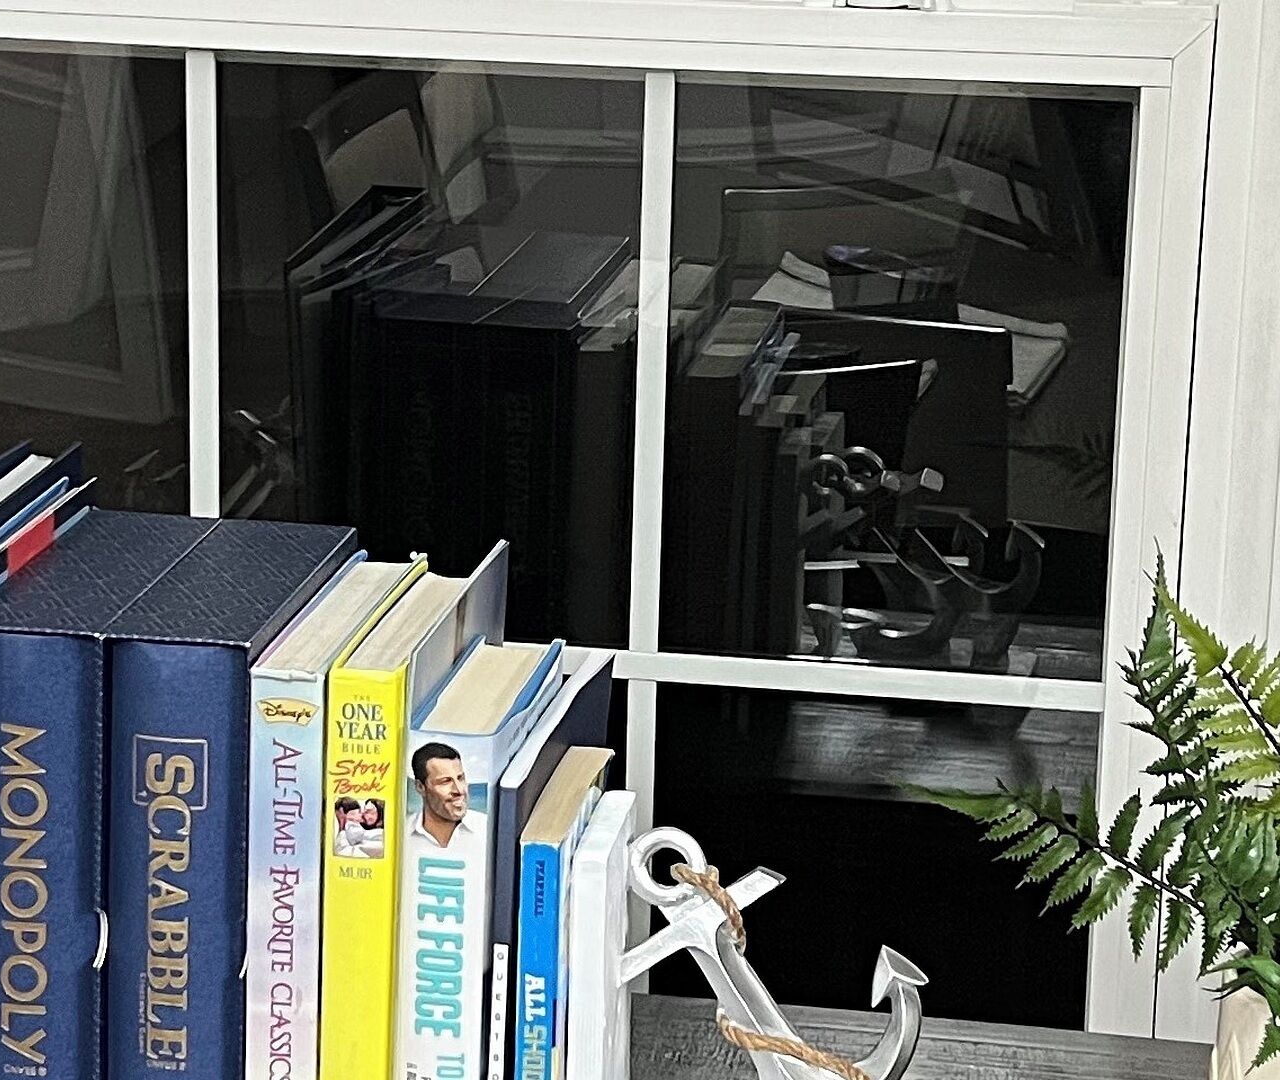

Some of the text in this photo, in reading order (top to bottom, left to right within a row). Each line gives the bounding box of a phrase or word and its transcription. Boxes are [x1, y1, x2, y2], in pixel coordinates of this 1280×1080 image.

[342, 703, 384, 721] ONE
[336, 720, 387, 740] YEAR
[342, 742, 381, 755] BIBLE
[329, 759, 391, 780] Story
[333, 776, 386, 795] Book
[0, 722, 48, 1064] MONOPOLY
[145, 752, 195, 1060] SCRABBLE
[267, 864, 299, 973] FAVORITE
[415, 857, 465, 1038] LIFE FORCE
[524, 973, 547, 1022] ALL
